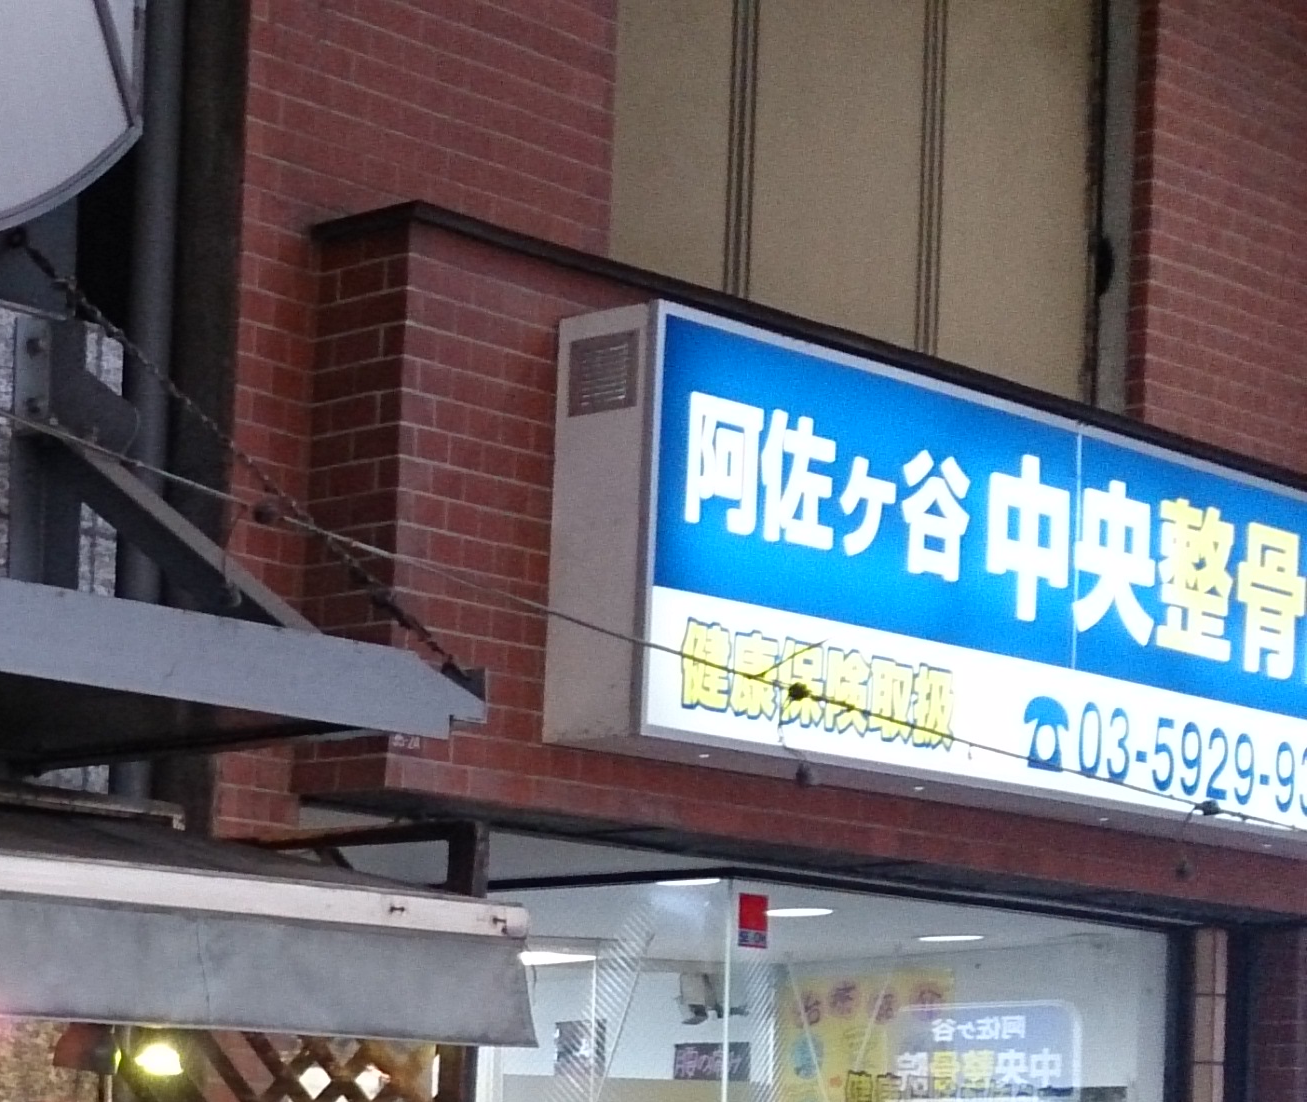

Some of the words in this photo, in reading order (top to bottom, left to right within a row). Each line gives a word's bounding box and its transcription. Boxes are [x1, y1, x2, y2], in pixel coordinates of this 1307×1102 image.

[681, 617, 953, 750] 健康保険取扱
